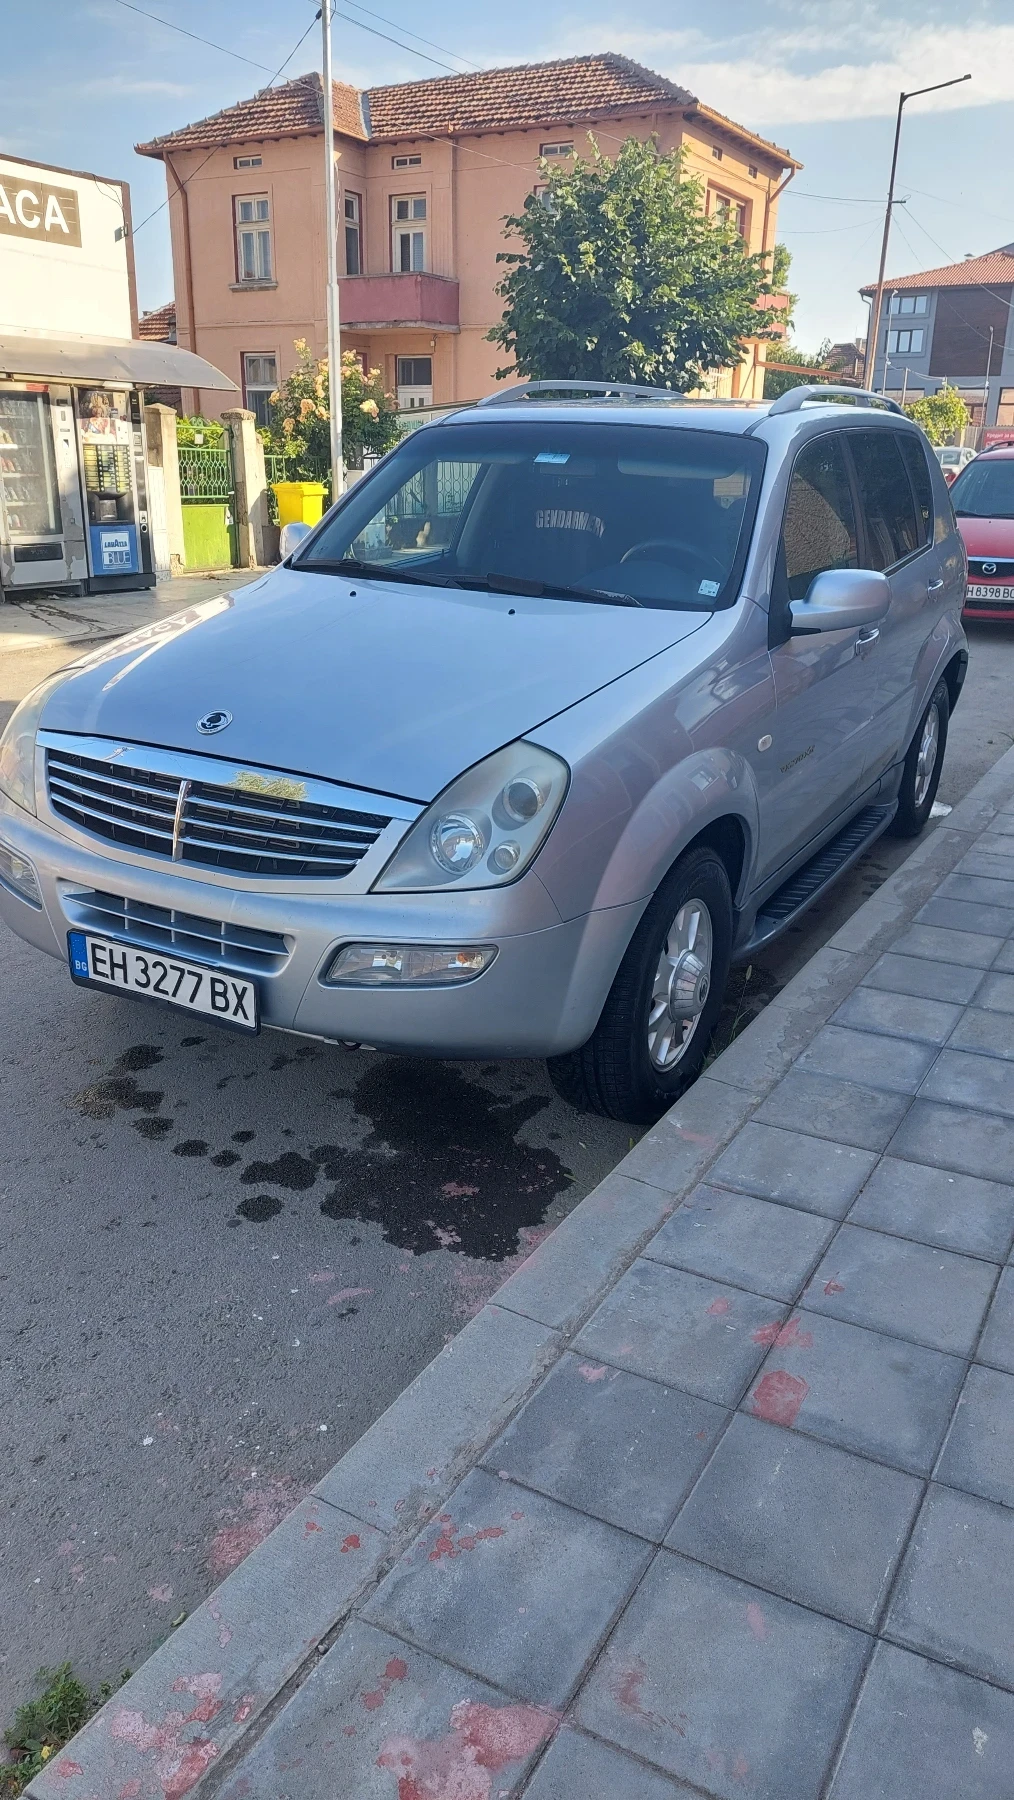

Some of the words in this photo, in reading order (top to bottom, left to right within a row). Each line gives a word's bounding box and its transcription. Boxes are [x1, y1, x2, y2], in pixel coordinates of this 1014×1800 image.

[104, 551, 130, 565] BLUE
[975, 586, 1000, 598] 8398
[75, 960, 88, 972] BG
[91, 943, 128, 984] EH
[134, 955, 203, 1003] 3277
[210, 976, 250, 1020] BX
